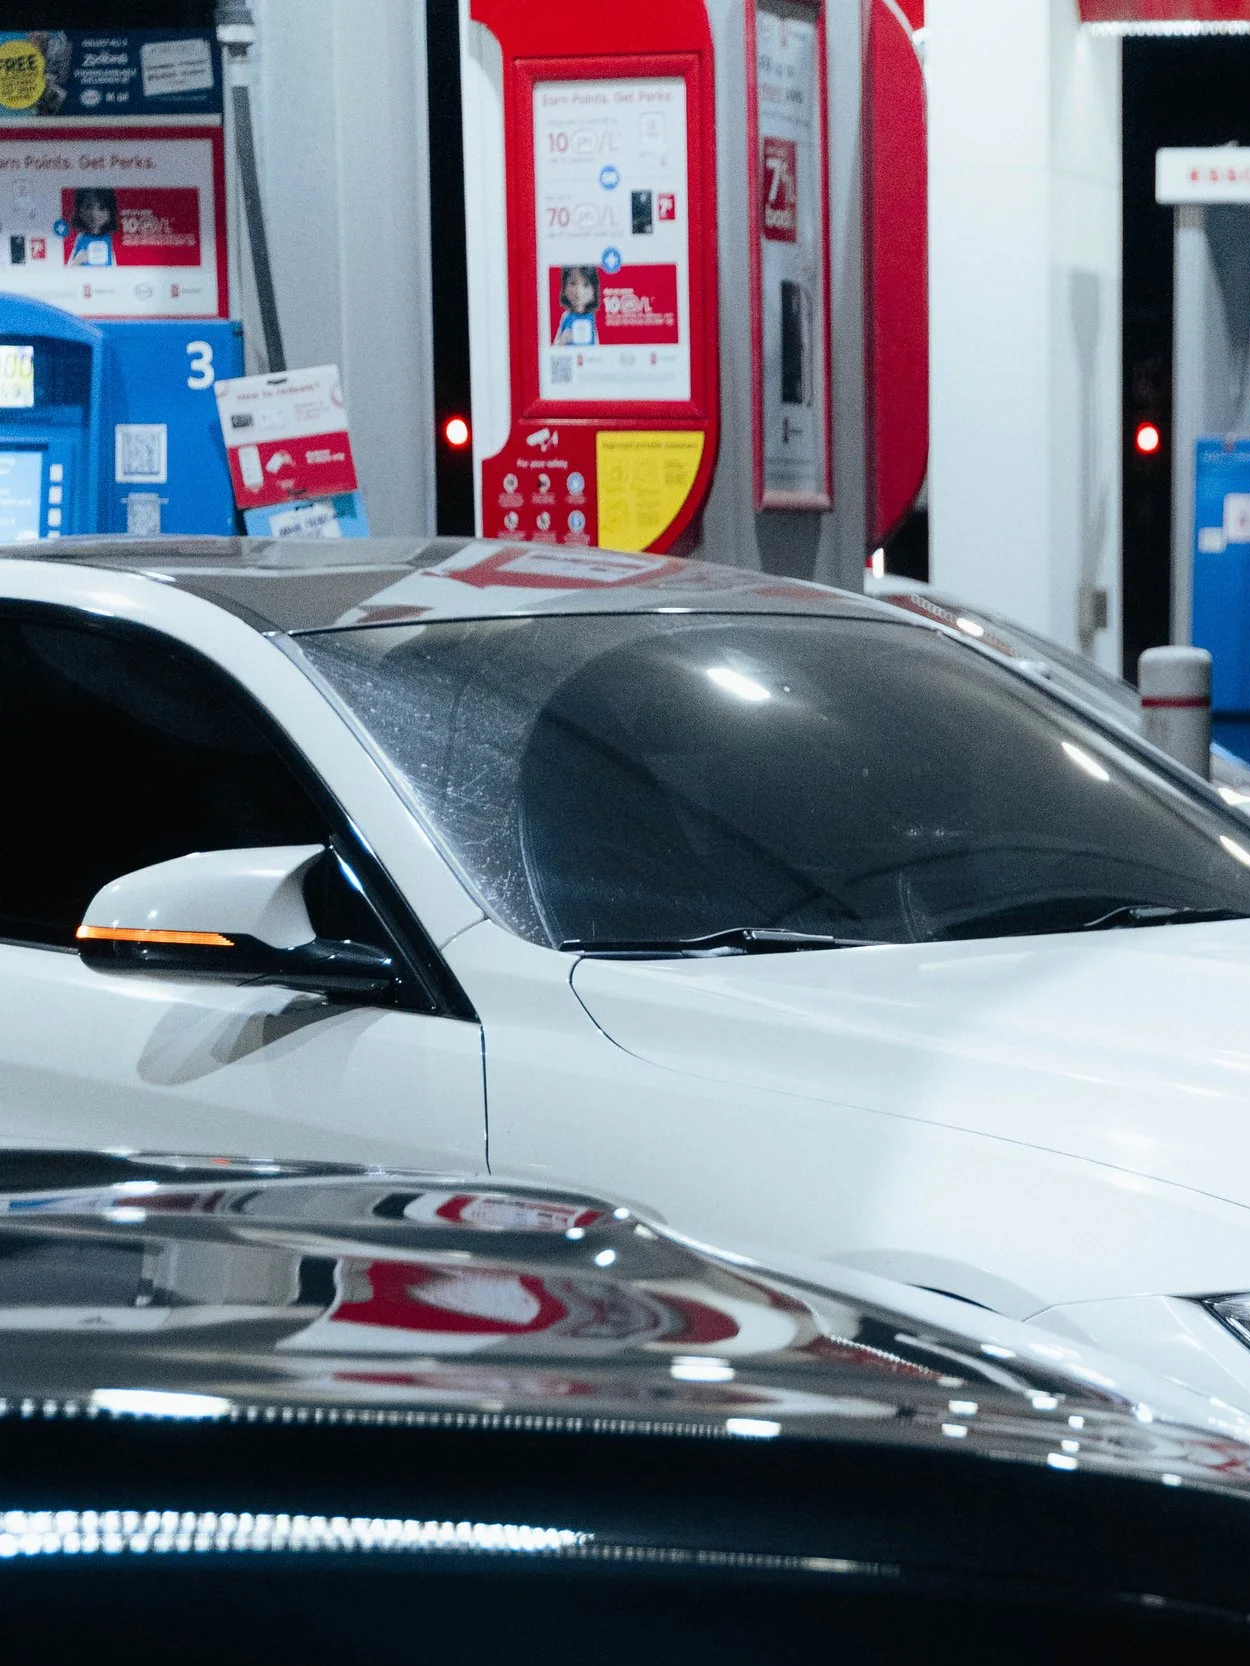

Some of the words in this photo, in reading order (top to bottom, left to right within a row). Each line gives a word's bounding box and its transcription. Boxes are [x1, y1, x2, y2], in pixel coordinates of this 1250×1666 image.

[548, 132, 568, 152] 10
[0, 158, 20, 170] arn
[546, 206, 570, 228] 70
[186, 340, 216, 390] 3
